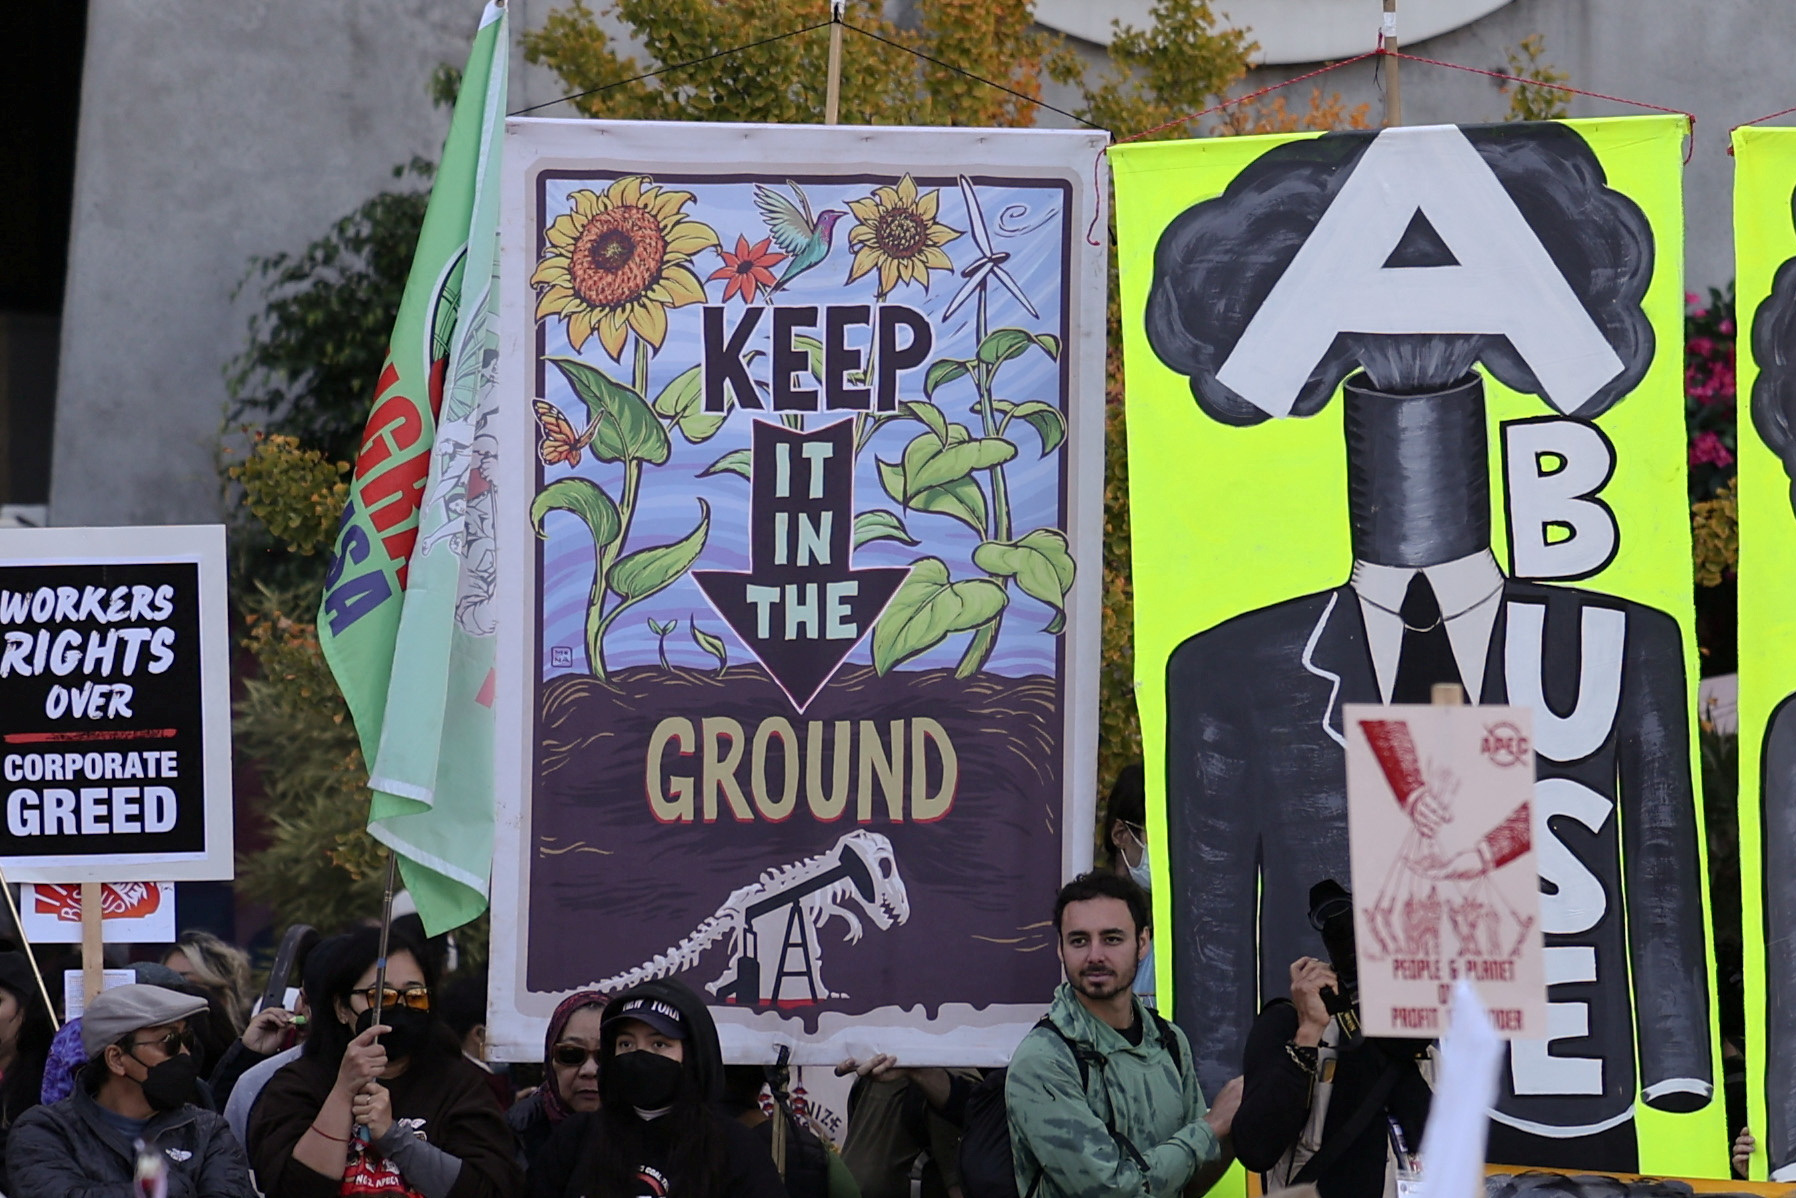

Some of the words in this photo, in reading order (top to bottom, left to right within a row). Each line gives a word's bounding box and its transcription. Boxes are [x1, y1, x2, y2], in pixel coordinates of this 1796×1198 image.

[702, 304, 932, 414] KEEP
[775, 441, 834, 500] IT
[774, 511, 831, 566] IN
[0, 584, 174, 625] WORKERS
[746, 579, 858, 641] THE
[0, 626, 175, 679] RIGHTS
[45, 681, 133, 720] OVER
[3, 750, 178, 781] CORPORATE
[645, 716, 958, 824] GROUND
[6, 786, 177, 837] GREED
[1392, 958, 1440, 981] PEOPLE
[1465, 959, 1516, 981] PLANET
[1391, 1007, 1439, 1029] PROFIT
